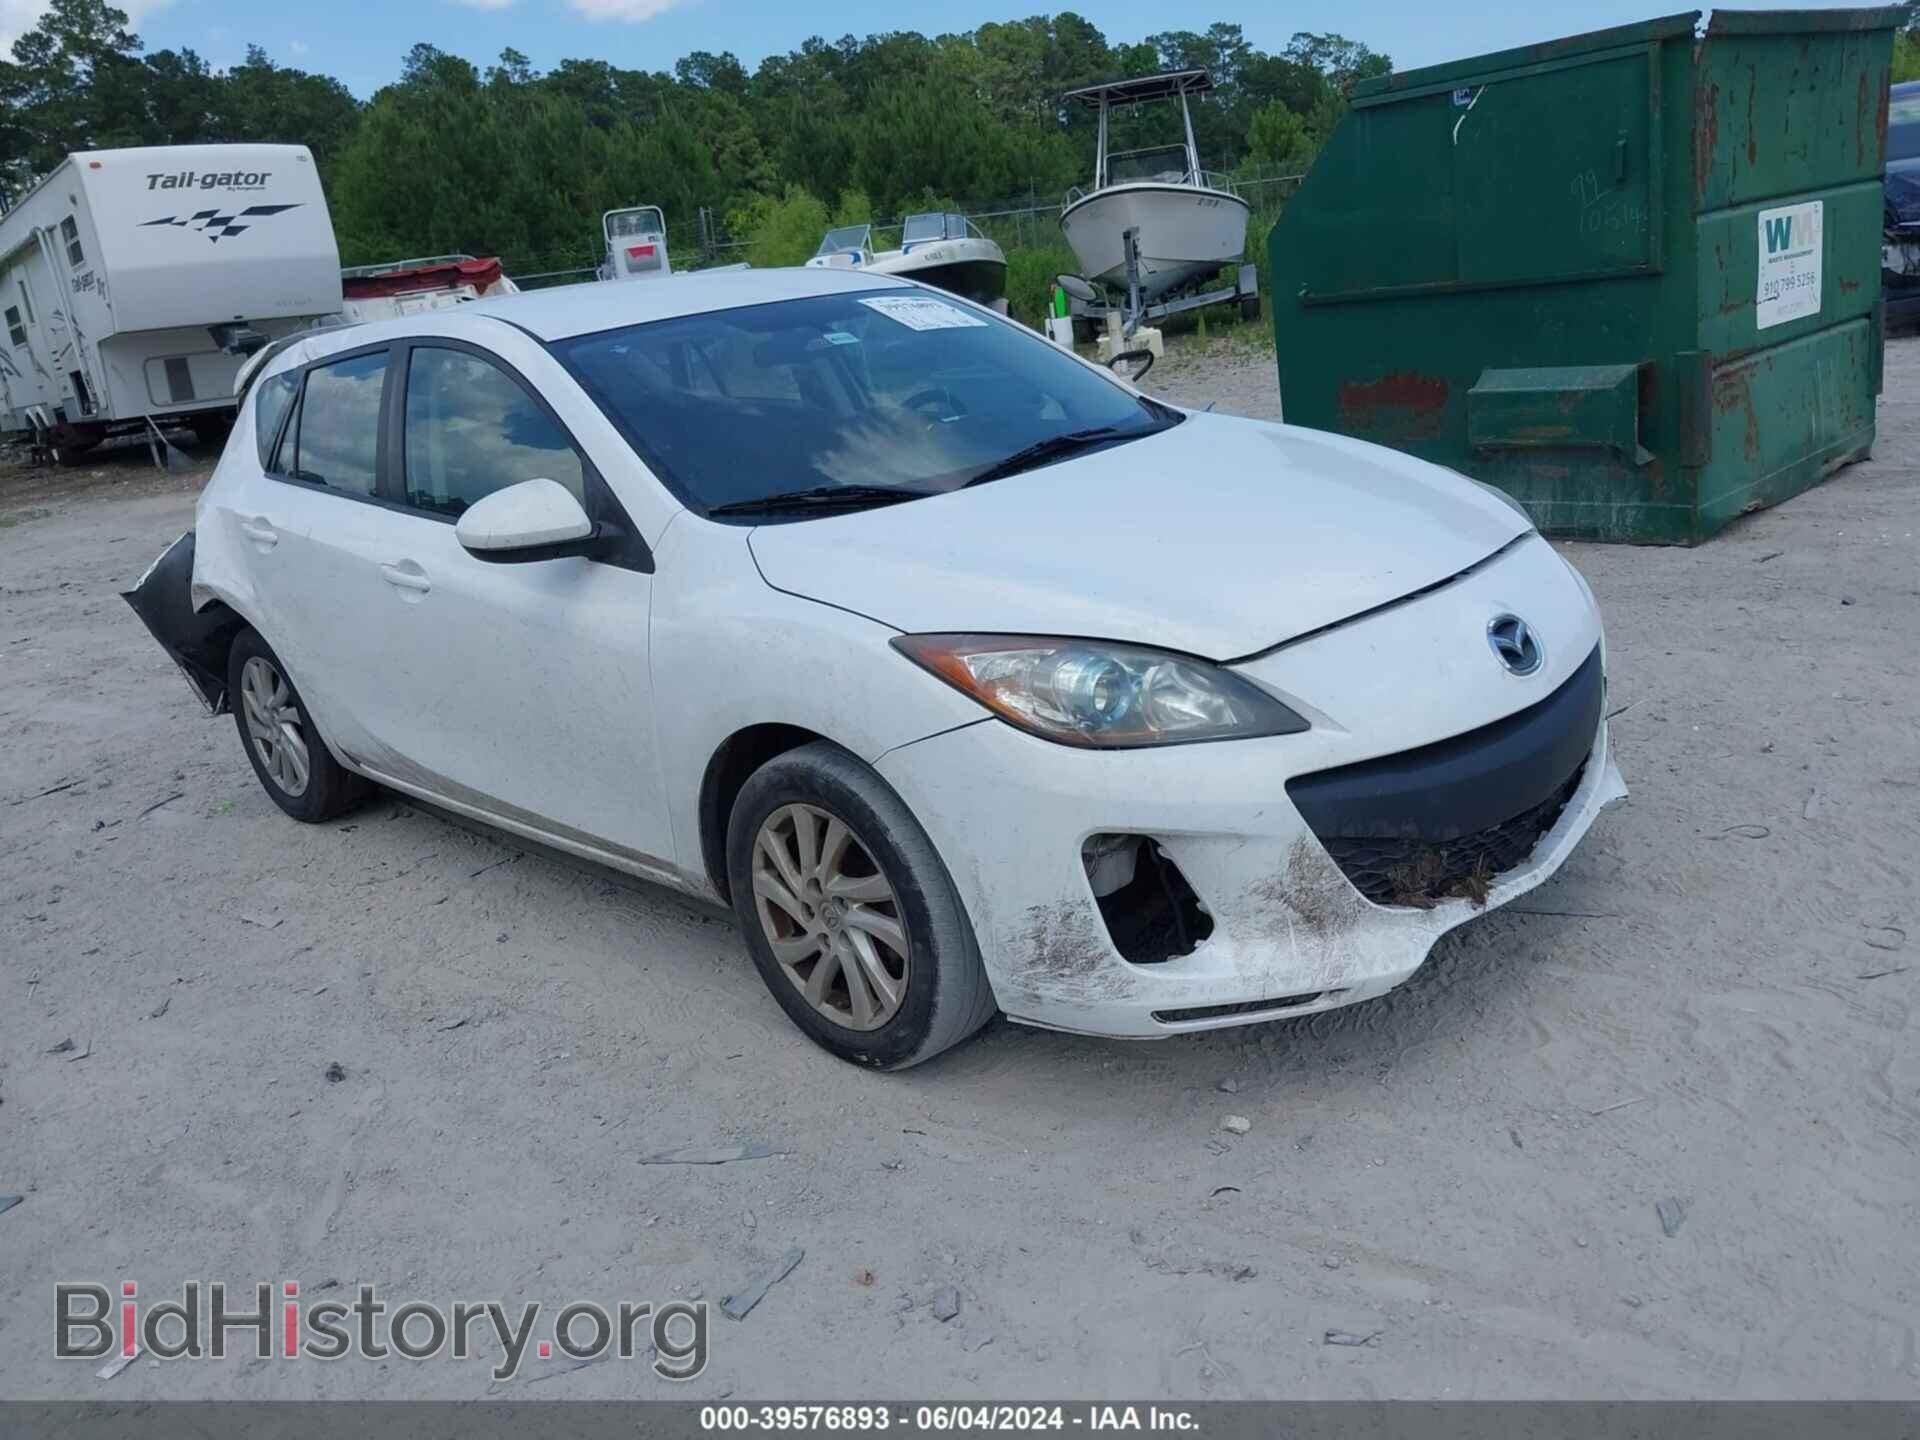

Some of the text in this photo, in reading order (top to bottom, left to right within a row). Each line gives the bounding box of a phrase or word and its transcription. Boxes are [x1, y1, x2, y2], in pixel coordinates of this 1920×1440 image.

[147, 170, 272, 190] Tail-gator
[1764, 280, 1779, 296] 910
[1780, 276, 1795, 291] 799
